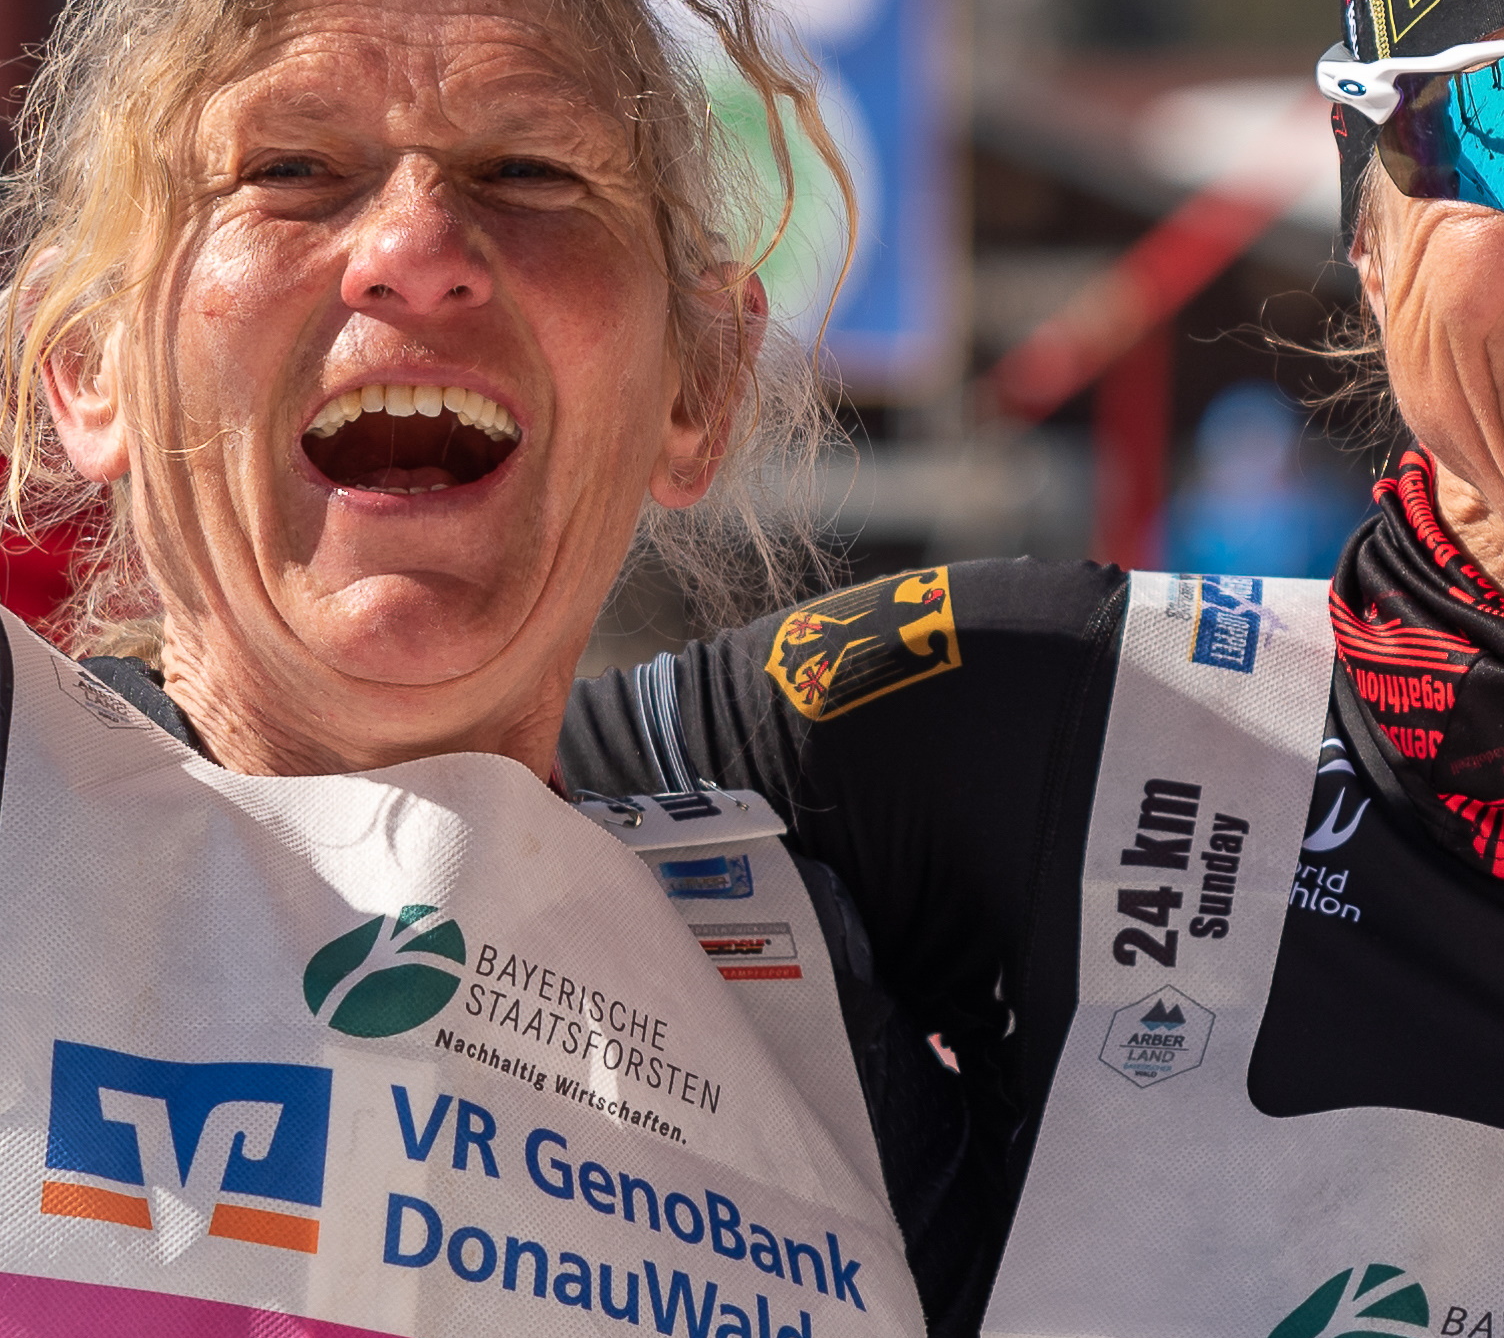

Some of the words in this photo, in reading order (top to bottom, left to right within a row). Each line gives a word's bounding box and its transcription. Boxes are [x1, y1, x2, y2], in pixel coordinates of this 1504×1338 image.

[1119, 777, 1203, 871] km
[1188, 812, 1251, 940] Sunday
[1112, 885, 1184, 968] 24
[465, 983, 721, 1114] STAATSFORSTEN
[475, 943, 669, 1052] BAYERISCHE
[1127, 1032, 1186, 1048] ARBER
[434, 1028, 549, 1092] Nachhaltig
[555, 1075, 688, 1145] Wirtschaften.
[1127, 1048, 1176, 1063] LAND
[390, 1081, 500, 1180] VR
[522, 1124, 867, 1315] GenoBank
